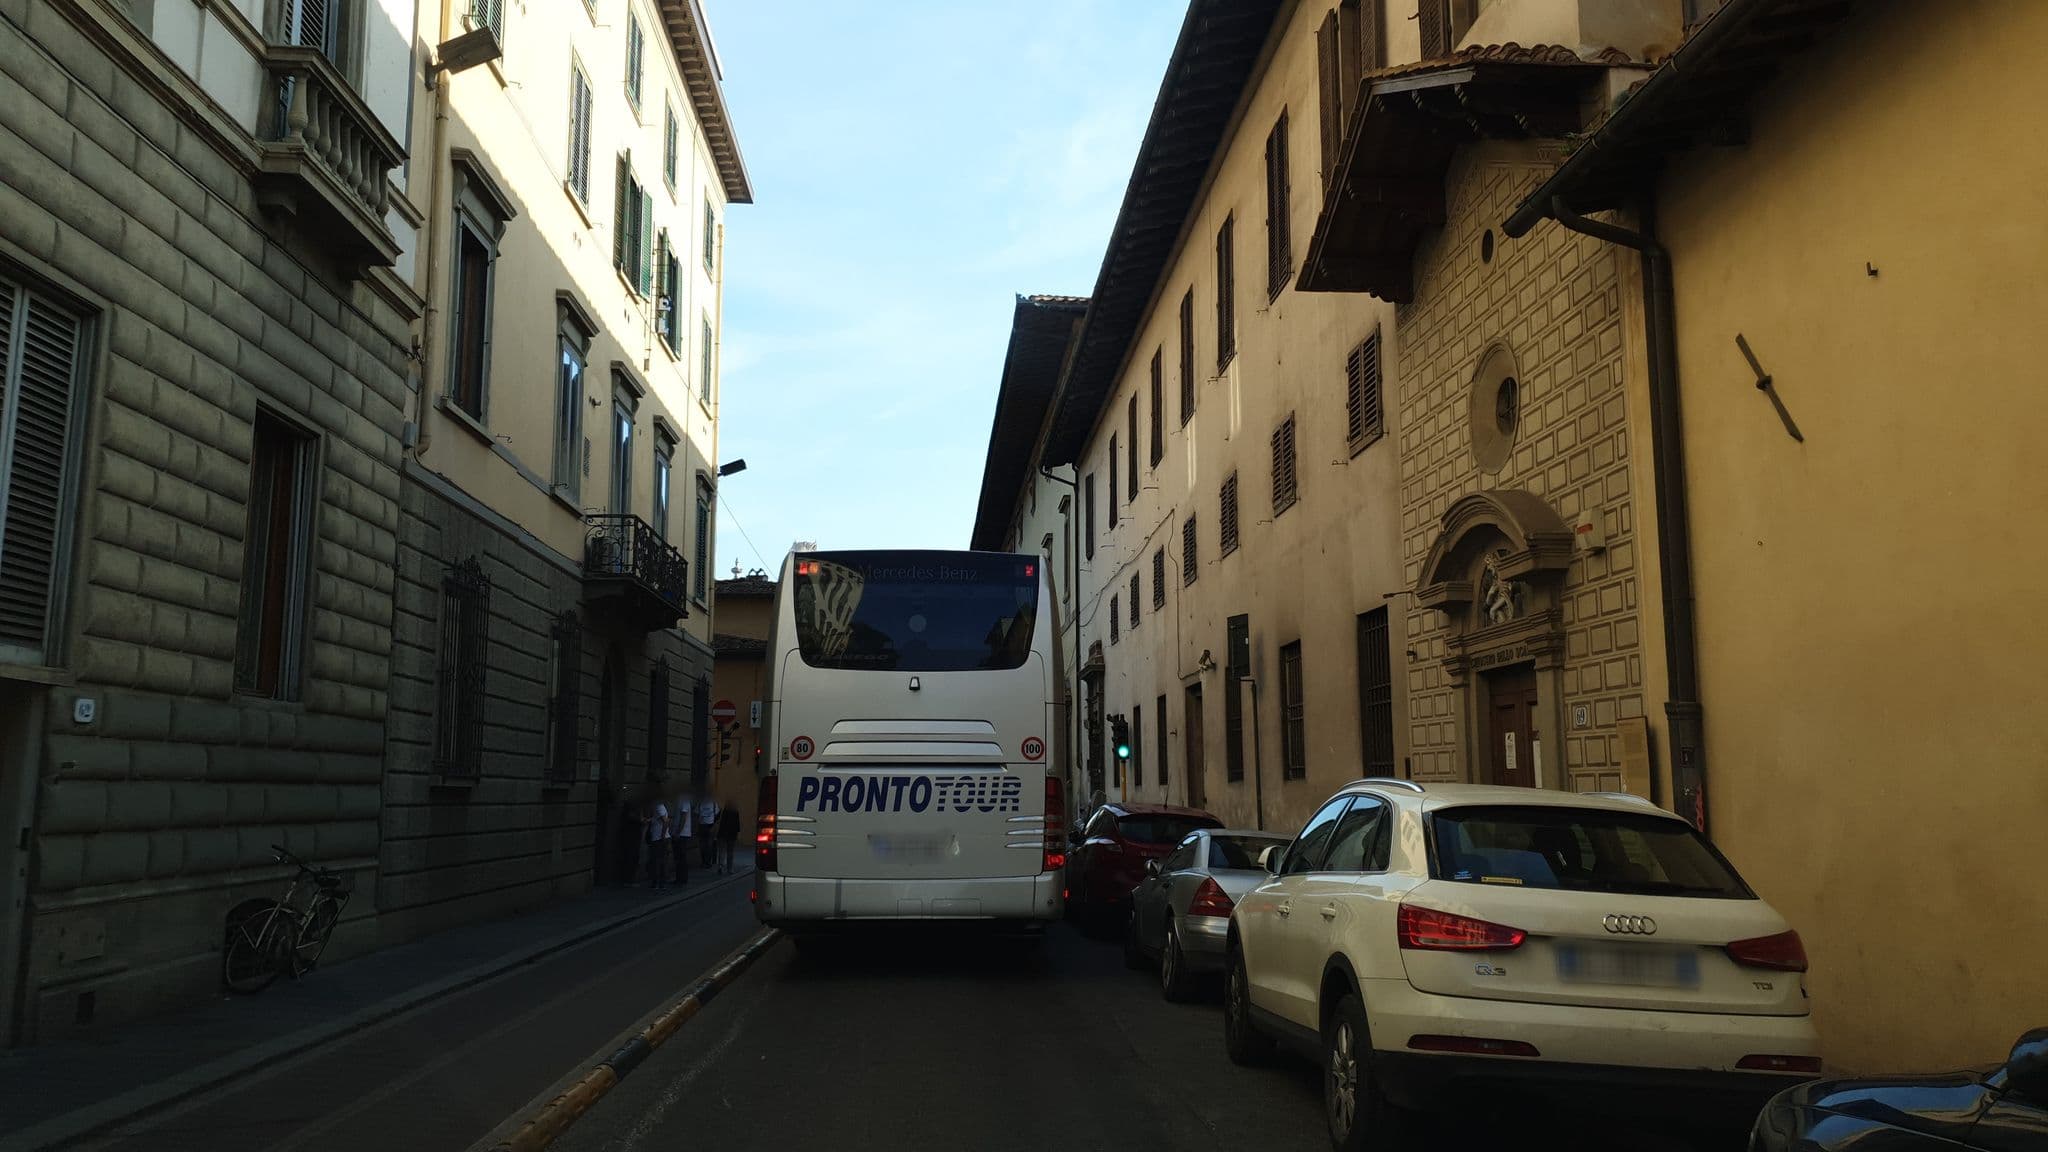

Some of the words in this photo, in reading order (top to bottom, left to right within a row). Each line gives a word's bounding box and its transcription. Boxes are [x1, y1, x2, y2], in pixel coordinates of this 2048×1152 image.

[797, 743, 809, 753] 80
[1026, 743, 1041, 754] 100
[797, 775, 1022, 813] PRONTOTOUR
[1475, 963, 1506, 977] Q3
[1752, 981, 1773, 990] TDI
